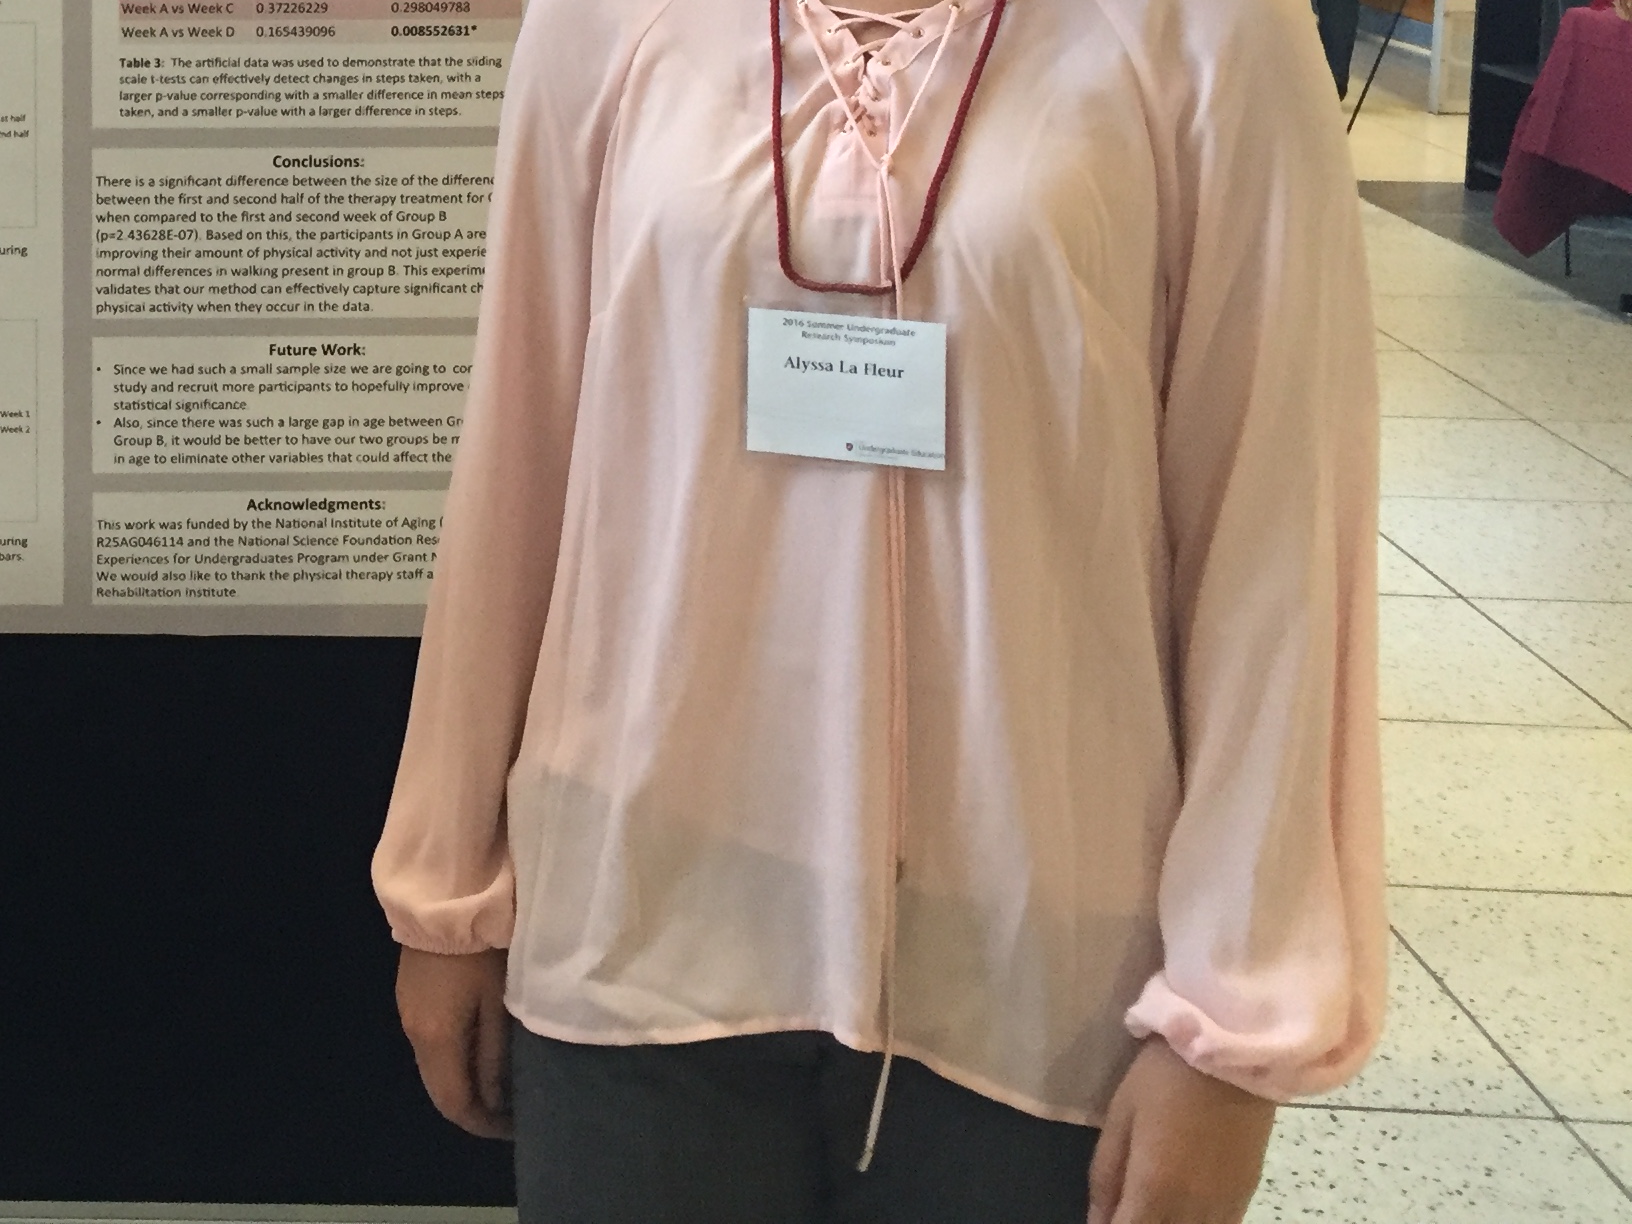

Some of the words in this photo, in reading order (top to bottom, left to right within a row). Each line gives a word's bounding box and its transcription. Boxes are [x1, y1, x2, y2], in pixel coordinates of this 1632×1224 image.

[272, 154, 364, 168] Conclusions:
[783, 318, 805, 328] 2016
[269, 343, 317, 356] Future
[321, 342, 365, 355] Work:
[784, 355, 833, 374] Alyssa
[839, 360, 857, 374] La
[864, 362, 904, 378] Fleur
[246, 497, 385, 513] Acknowledgments:
[97, 519, 121, 530] This
[124, 518, 155, 530] work
[158, 521, 182, 530] was
[186, 517, 229, 529] funded
[233, 518, 248, 531] by
[251, 517, 271, 529] the
[275, 517, 327, 529] National
[330, 517, 382, 528] Institute
[385, 516, 398, 528] of
[400, 516, 436, 530] Aging
